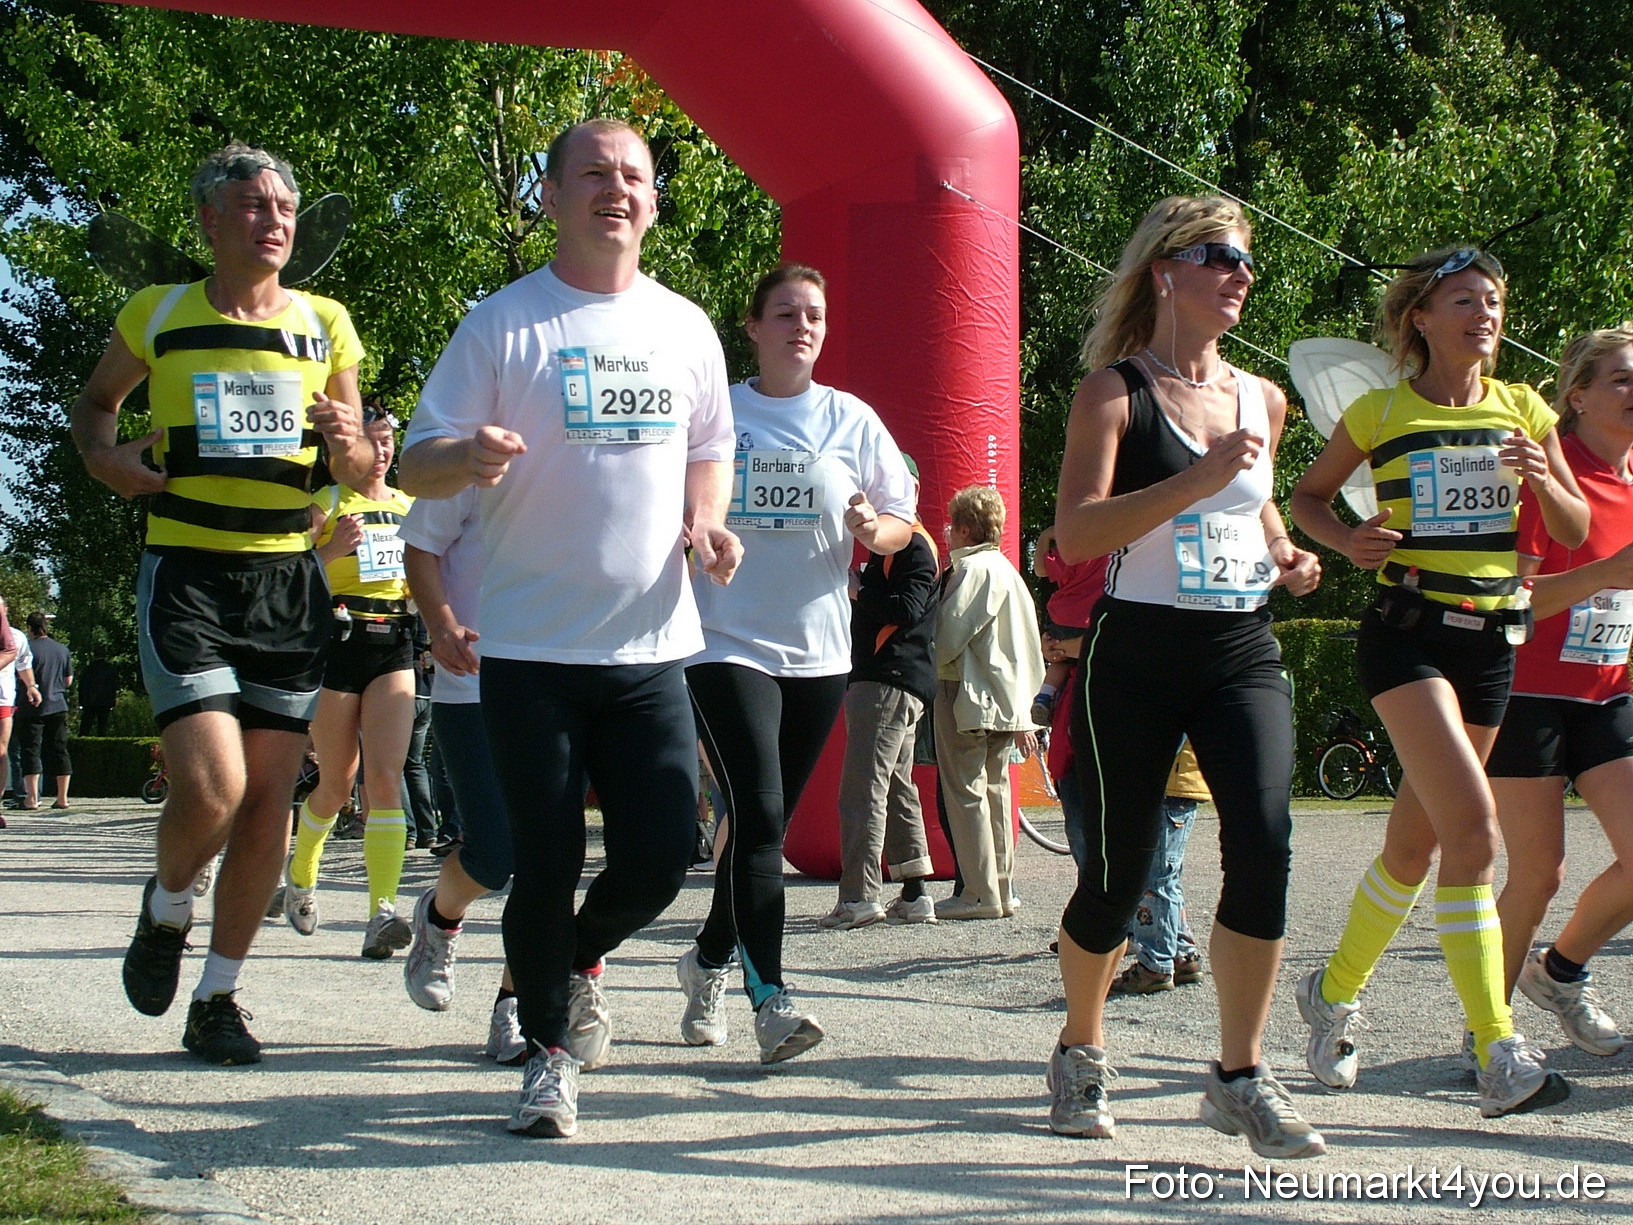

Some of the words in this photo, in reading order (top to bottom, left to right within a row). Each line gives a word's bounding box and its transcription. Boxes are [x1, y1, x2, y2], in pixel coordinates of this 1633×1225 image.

[594, 354, 649, 373] Markus
[224, 380, 275, 396] Markus
[569, 383, 577, 397] C
[200, 405, 208, 418] C
[600, 388, 673, 416] 2928
[229, 409, 295, 433] 3036
[566, 429, 613, 440] BOCK
[987, 434, 997, 464] 1929
[752, 457, 805, 474] Barbara
[1440, 456, 1495, 476] Siglinde
[753, 485, 815, 509] 3021
[1416, 484, 1424, 497] C
[1445, 485, 1511, 511] 2830
[1206, 521, 1239, 544] Lydia
[1413, 522, 1456, 532] BOCK
[1212, 555, 1272, 585] 2729
[1177, 595, 1223, 606] BOCK
[1594, 596, 1620, 612] Silke
[1590, 623, 1632, 644] 2778
